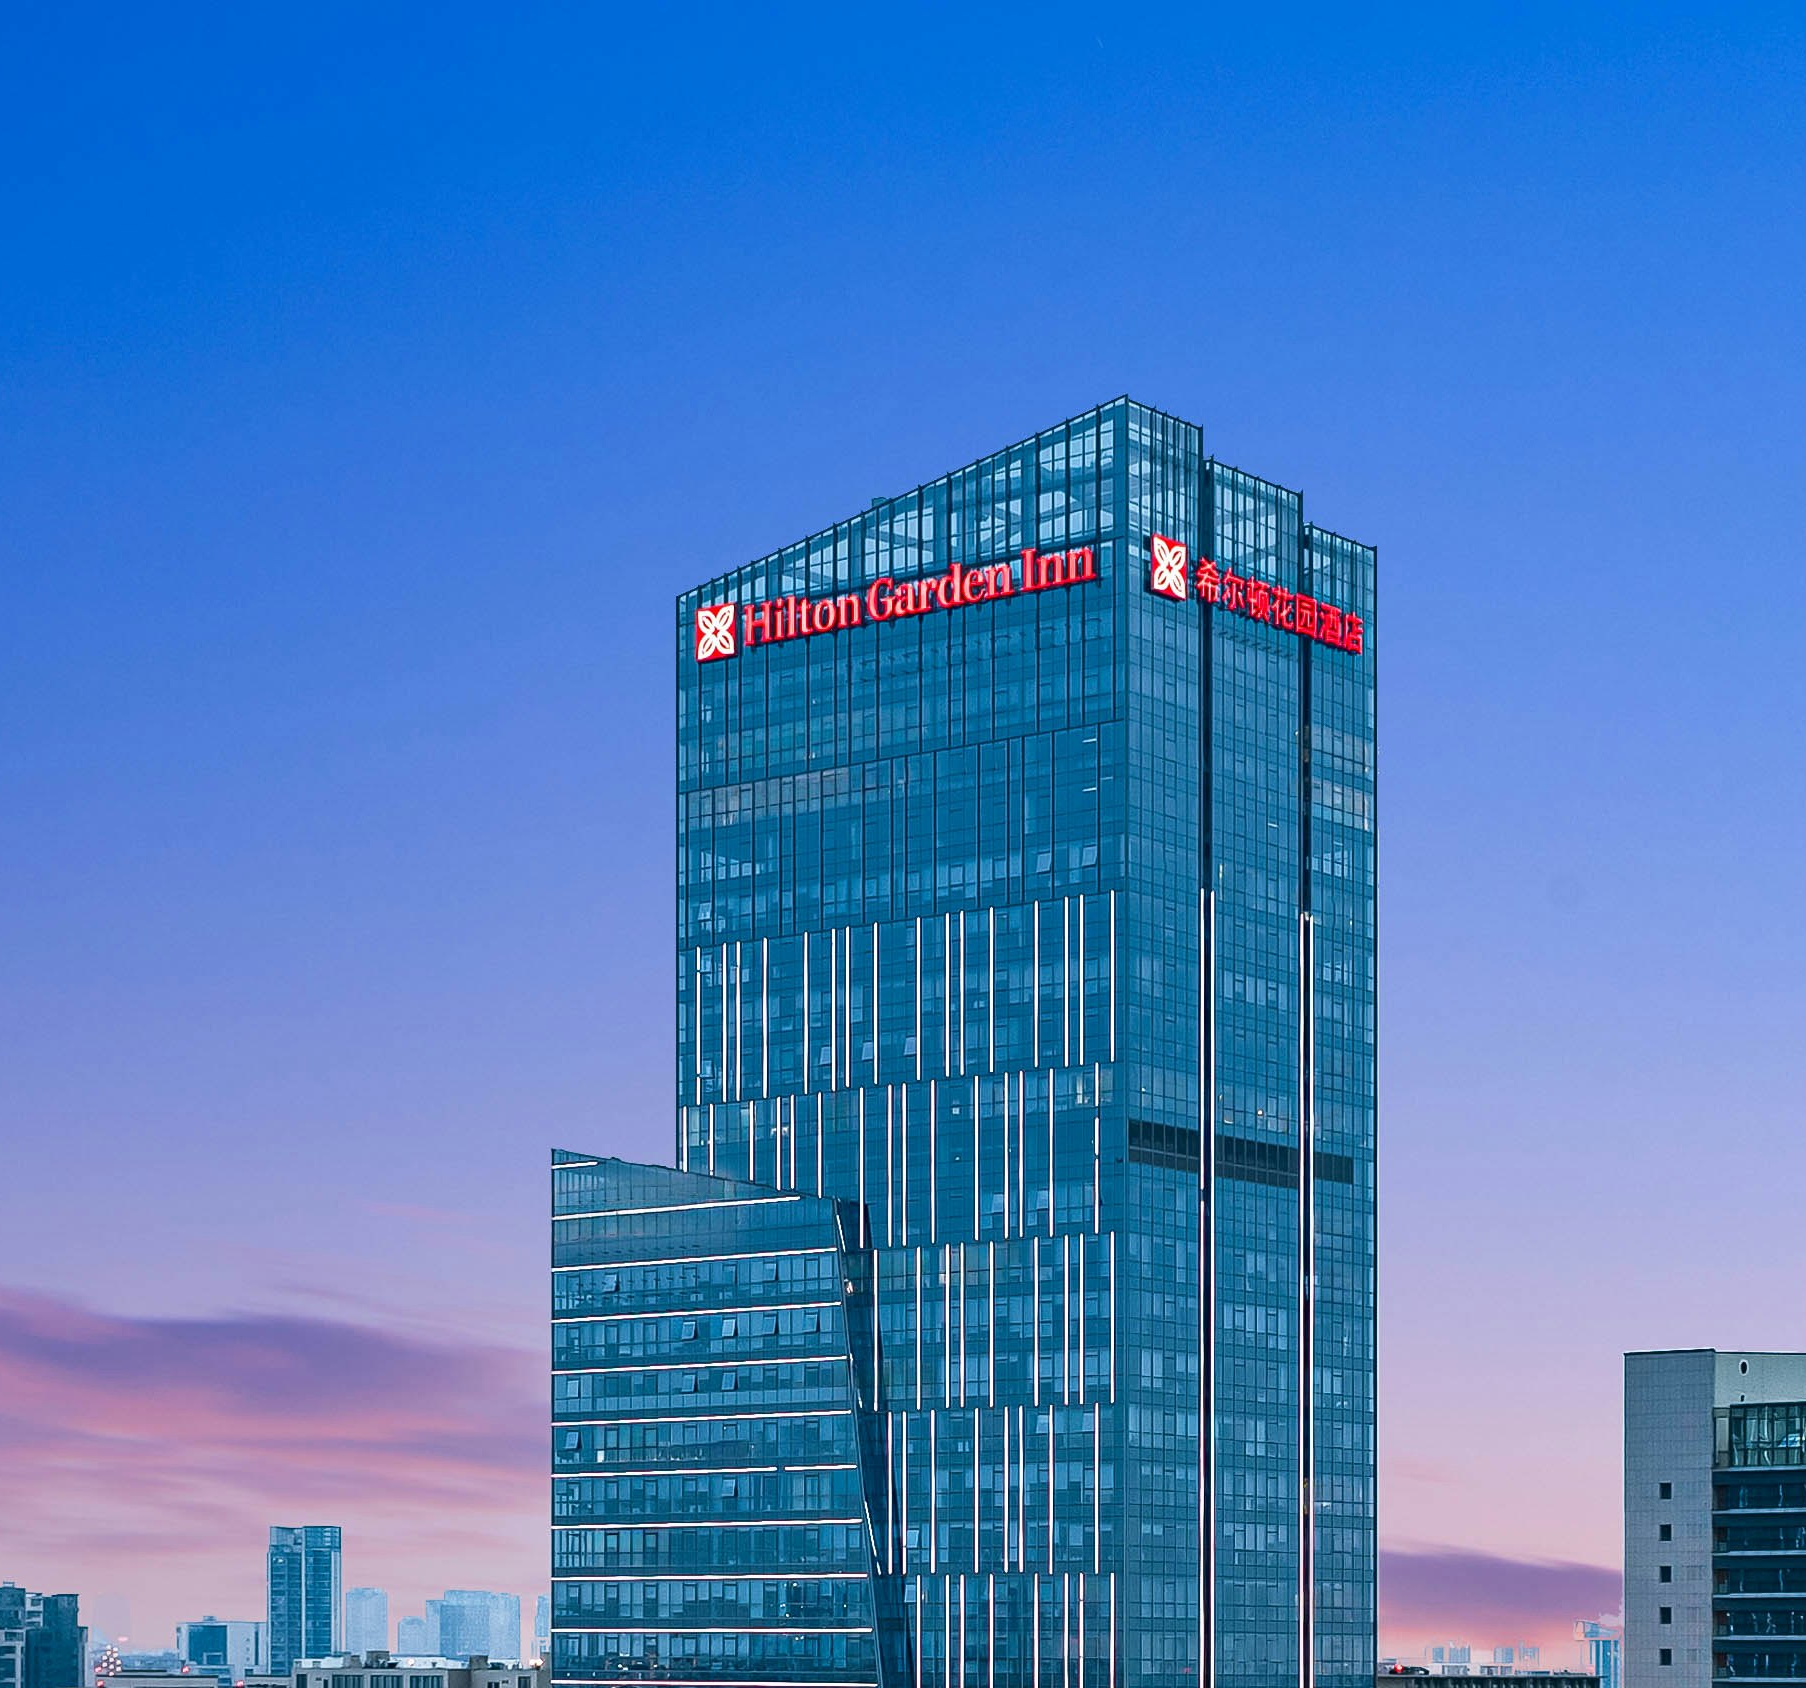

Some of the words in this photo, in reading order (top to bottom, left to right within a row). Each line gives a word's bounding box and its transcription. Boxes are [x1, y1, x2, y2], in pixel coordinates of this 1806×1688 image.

[744, 592, 862, 647] Hilton
[866, 562, 1015, 622] Garden
[1019, 546, 1097, 592] Inn
[1195, 557, 1364, 655] 希尔顿花园酒店
